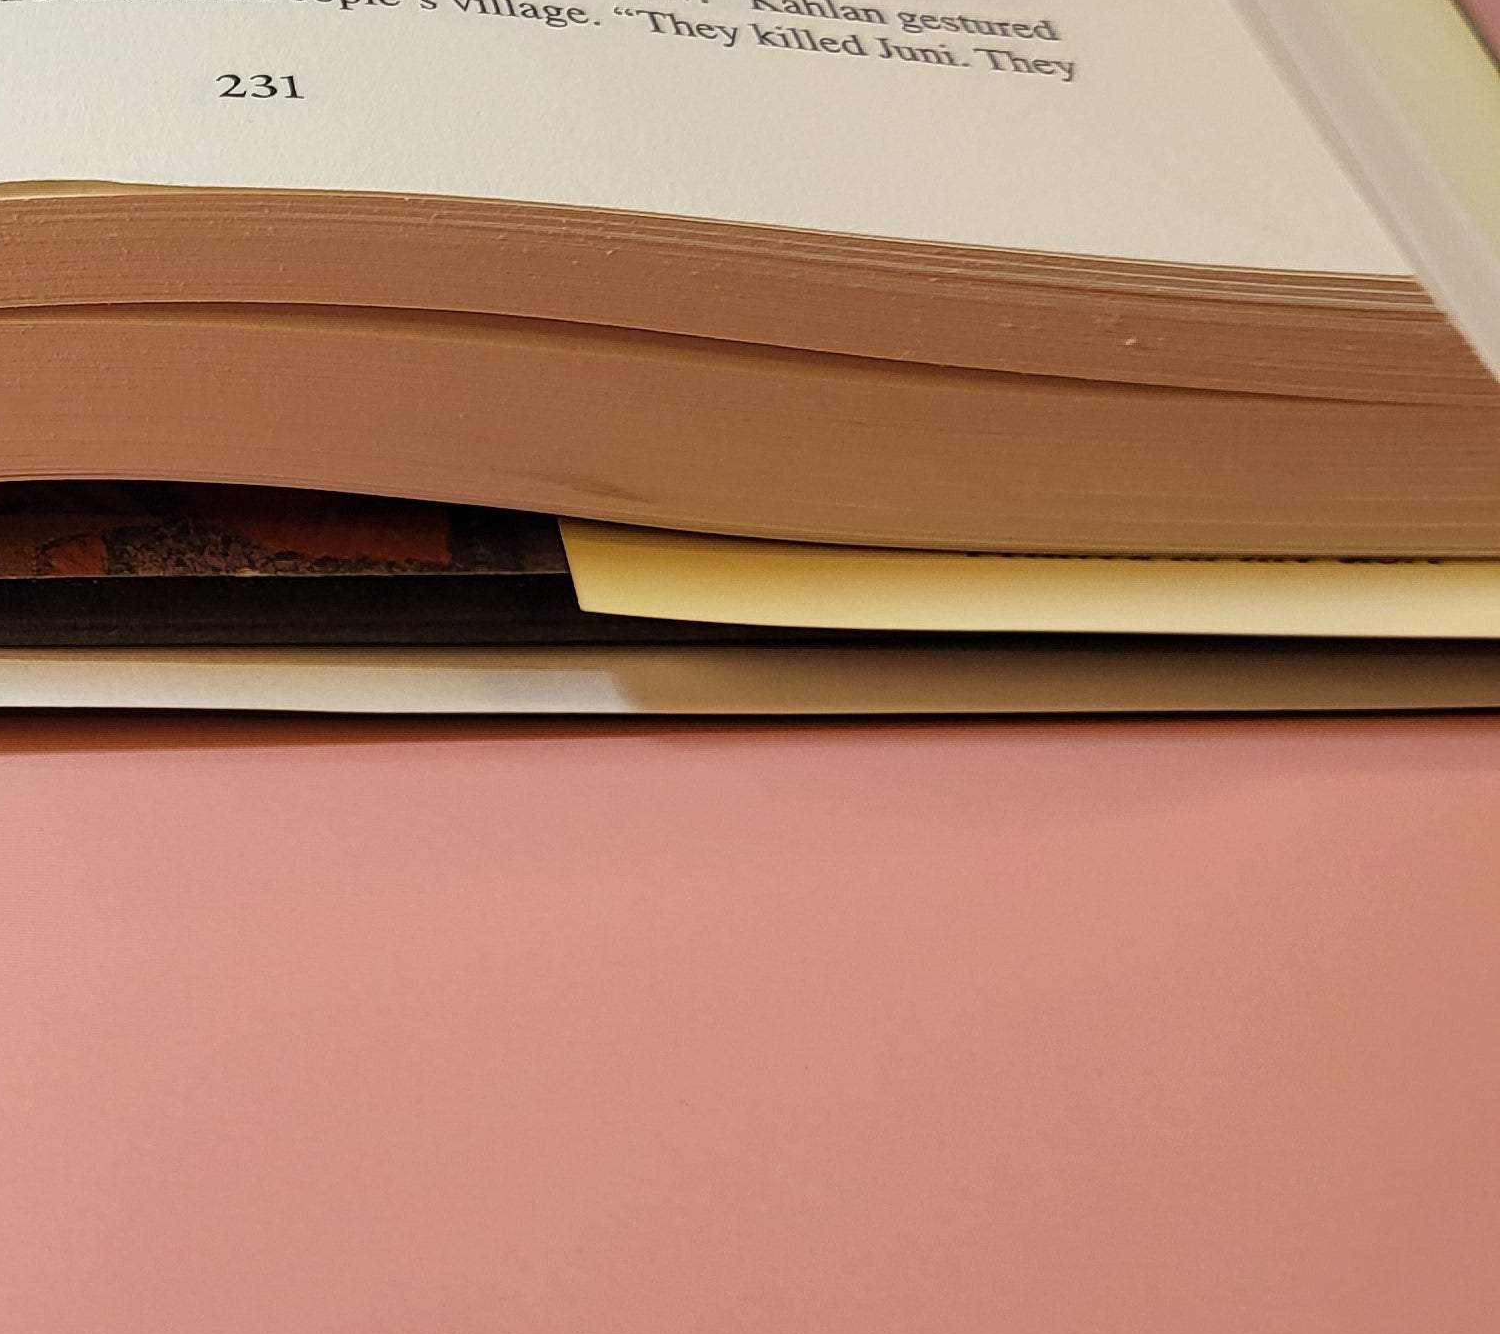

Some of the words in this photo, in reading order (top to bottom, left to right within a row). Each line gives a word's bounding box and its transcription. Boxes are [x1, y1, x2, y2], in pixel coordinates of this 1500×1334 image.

[895, 10, 1062, 42] gestured
[612, 5, 740, 49] “They
[746, 21, 870, 58] killed
[873, 35, 972, 69] Juni.
[970, 46, 1076, 84] They
[215, 73, 305, 99] 231
